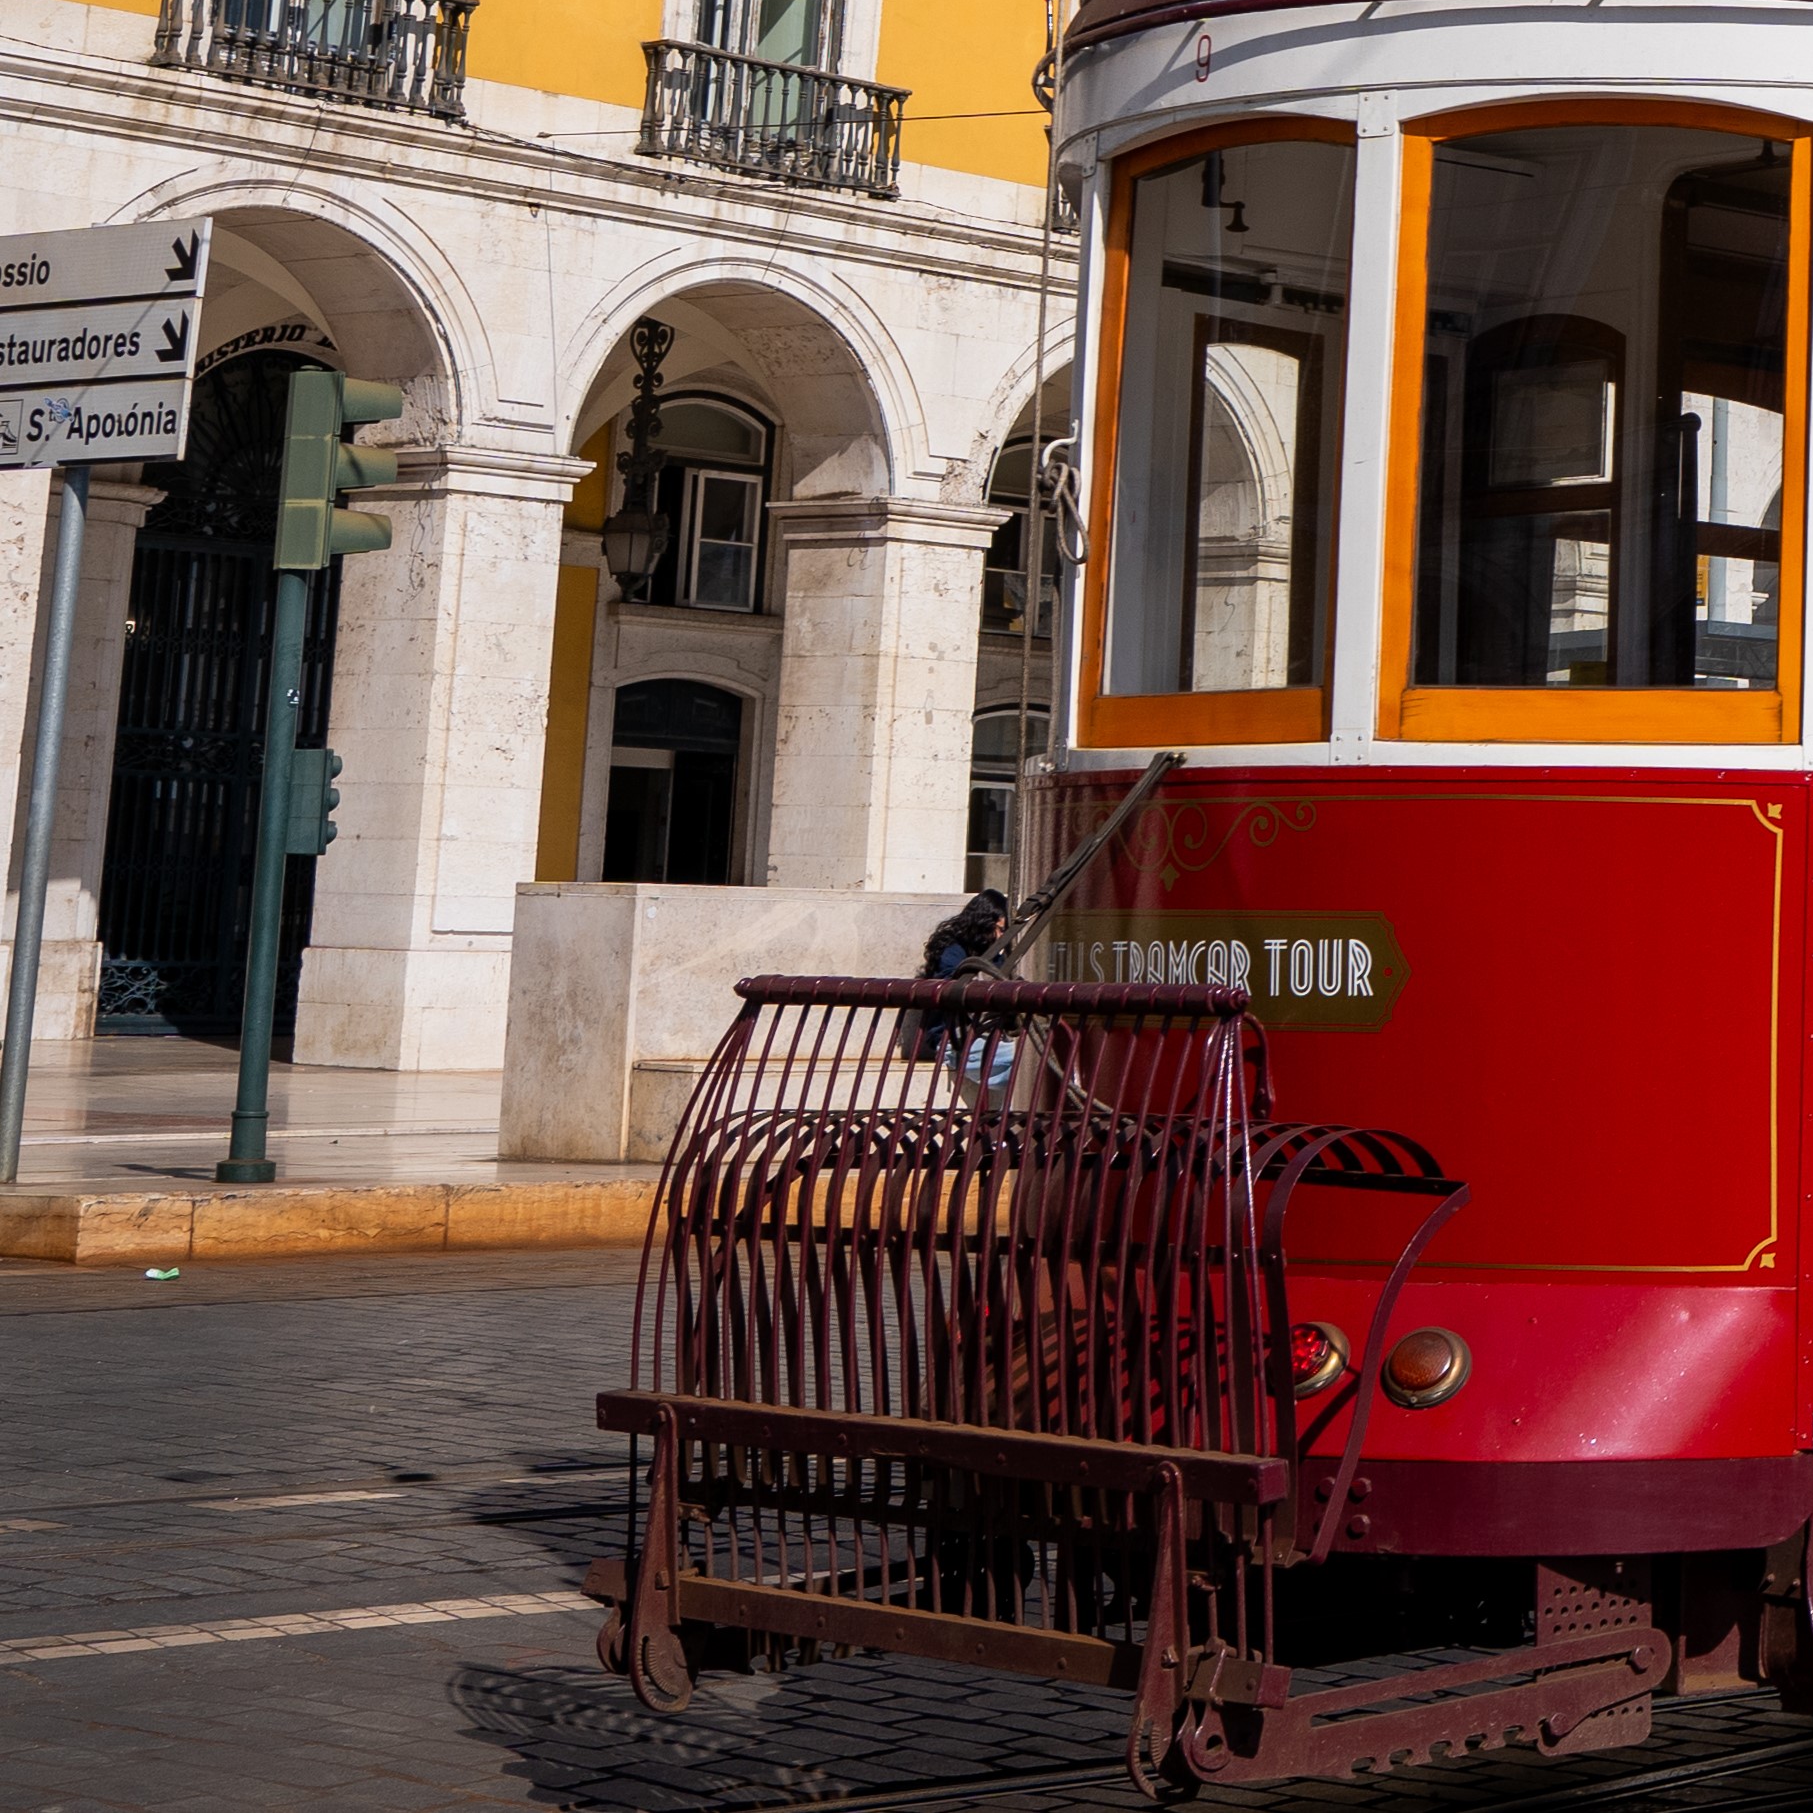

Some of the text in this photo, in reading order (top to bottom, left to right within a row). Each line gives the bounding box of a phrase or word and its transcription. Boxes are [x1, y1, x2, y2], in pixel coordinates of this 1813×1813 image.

[1195, 35, 1211, 82] 9
[0, 253, 50, 287] ssio
[1112, 939, 1252, 996] TRAMCAR
[1264, 938, 1374, 997] TOUR
